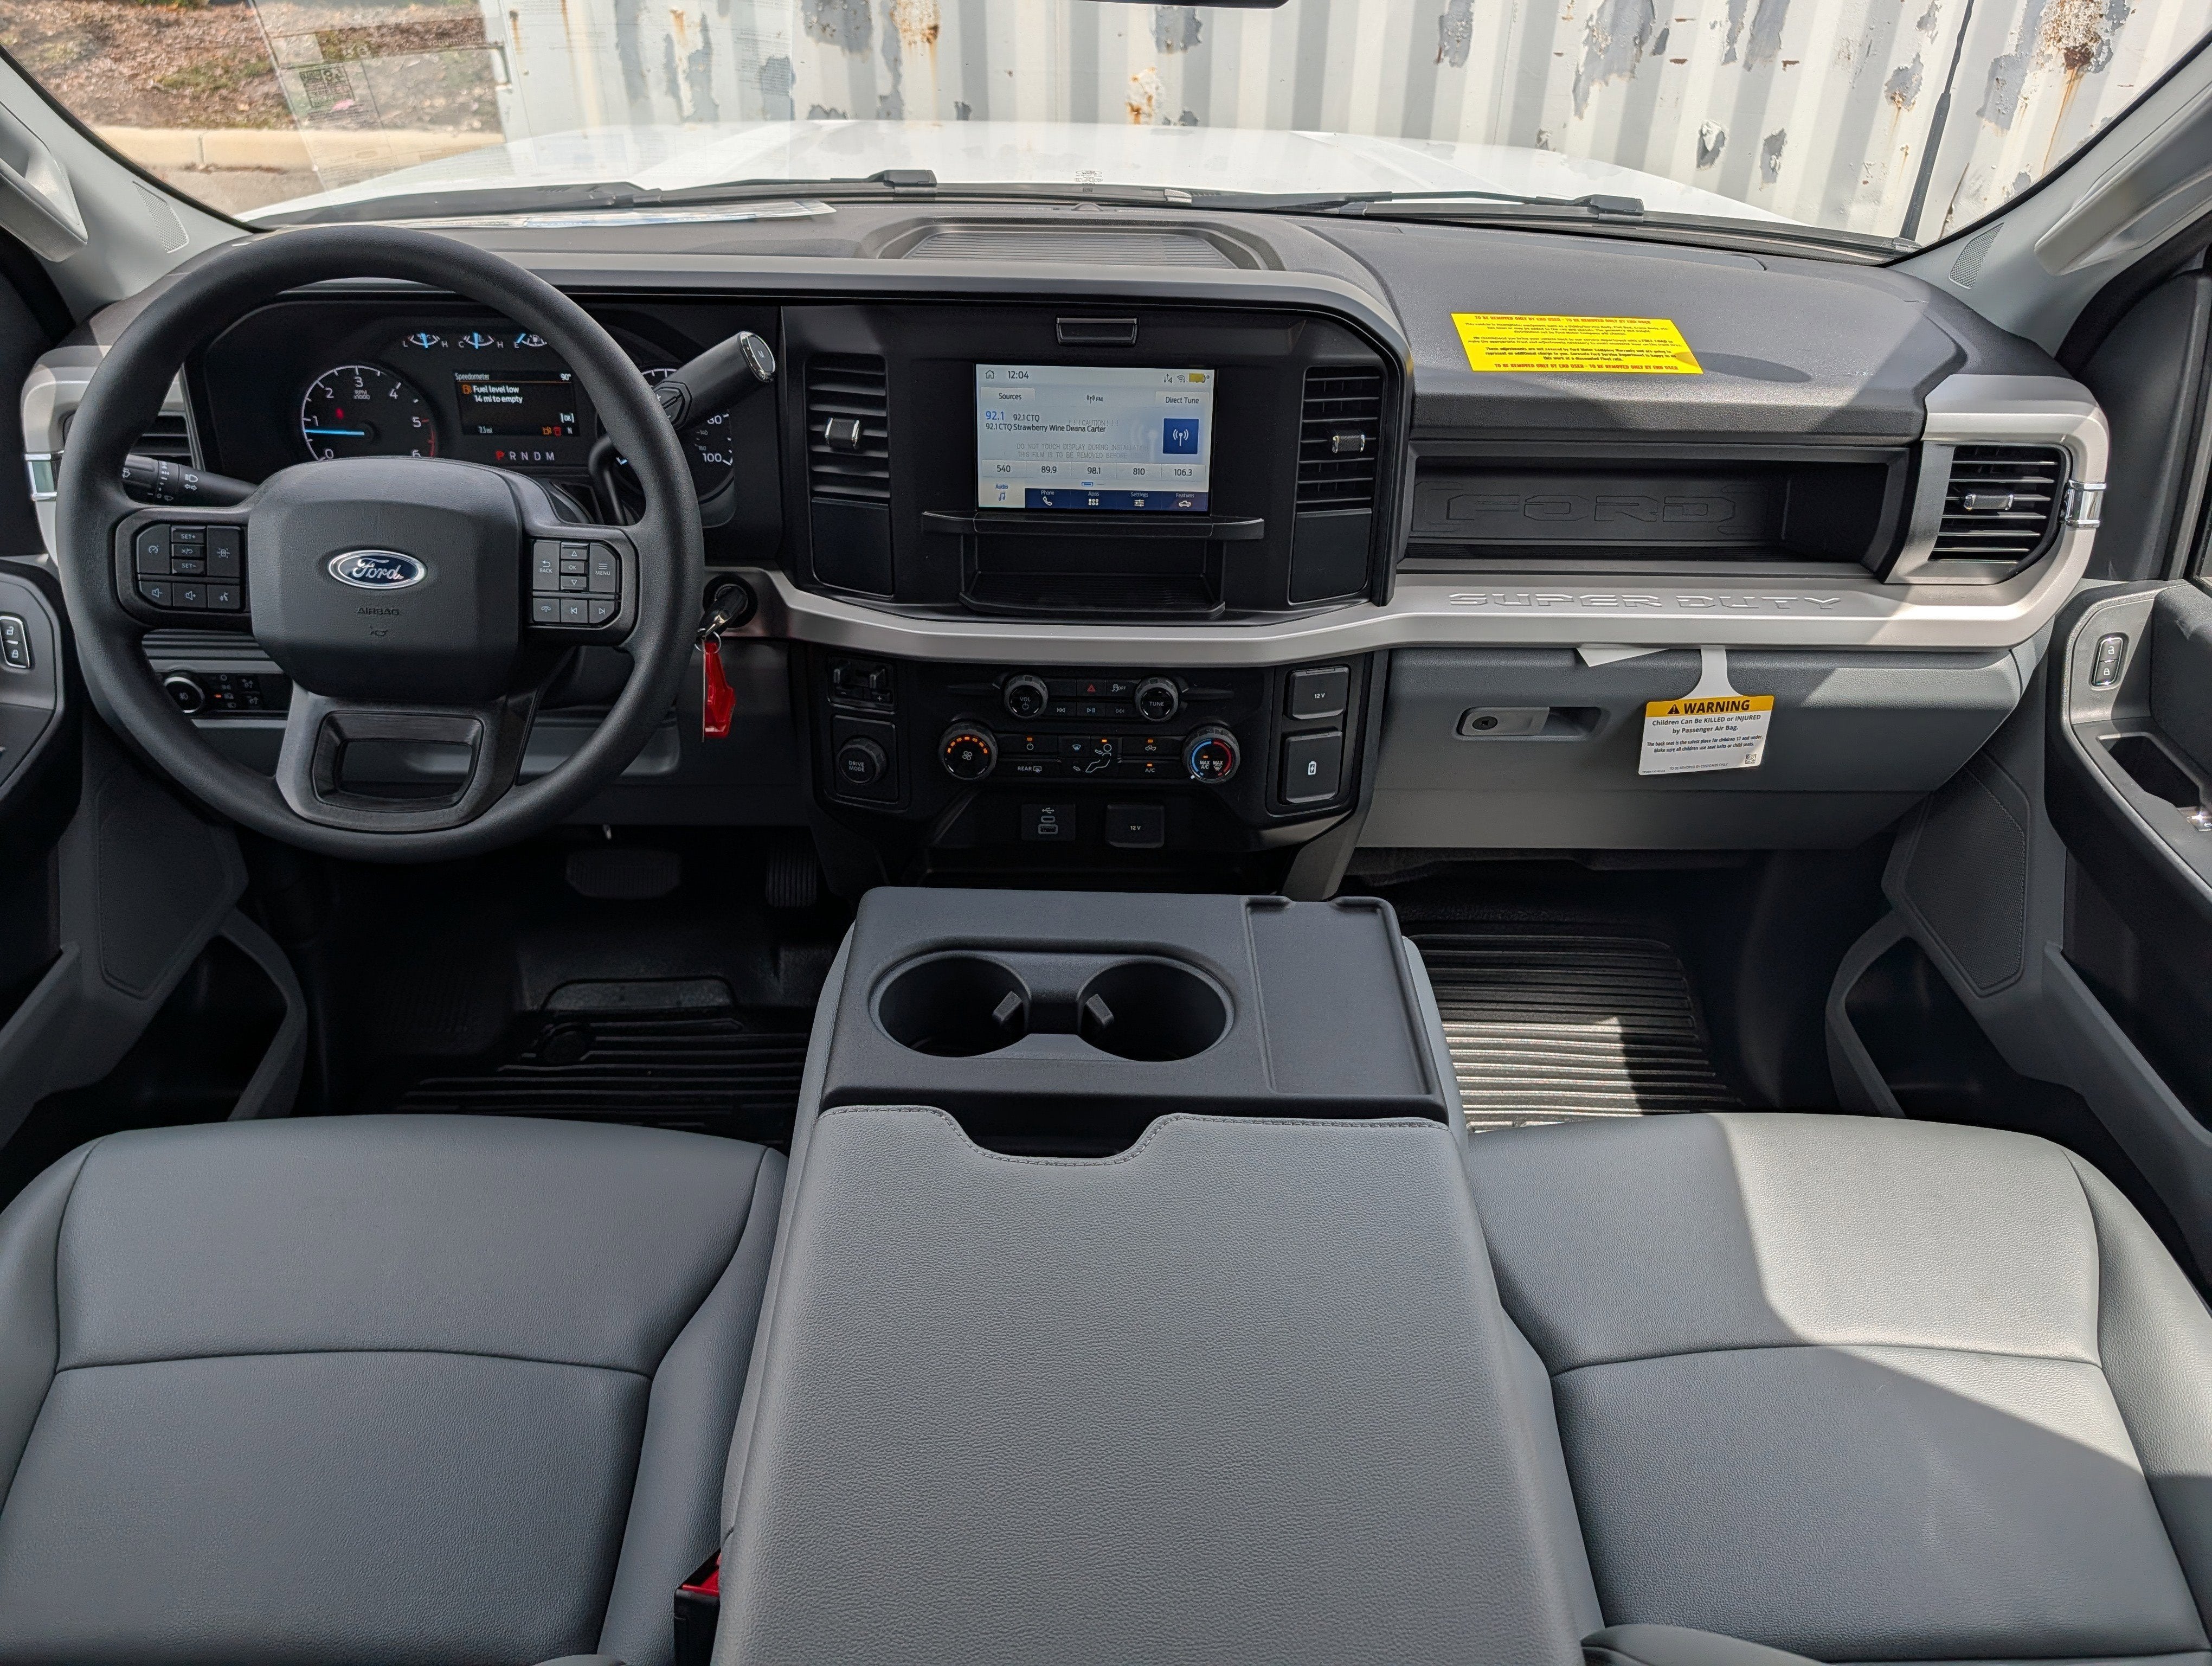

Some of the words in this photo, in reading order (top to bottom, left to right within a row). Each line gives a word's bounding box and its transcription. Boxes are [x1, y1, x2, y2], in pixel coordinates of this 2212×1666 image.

[454, 373, 490, 381] Speedometer
[1007, 370, 1029, 379] 12:04
[354, 376, 363, 388] 3
[325, 387, 334, 399] 2
[388, 388, 398, 399] 4
[472, 385, 488, 393] Fuel
[489, 385, 505, 393] level
[506, 385, 519, 393] low
[985, 411, 1004, 420] 92.1
[1026, 414, 1040, 422] CTQ
[312, 415, 319, 427] 1
[411, 416, 422, 428] 5
[999, 424, 1012, 432] CTQ
[1013, 424, 1047, 432] Strawberry
[325, 448, 334, 459] 0
[411, 449, 421, 457] 6
[495, 450, 505, 460] P
[509, 451, 517, 460] R
[520, 451, 529, 460] N
[533, 451, 541, 460] D
[545, 451, 555, 460] M
[703, 453, 722, 463] 100
[1447, 494, 1734, 523] FORD
[352, 558, 404, 580] Ford
[1449, 593, 1663, 608] SUPER
[1676, 595, 1841, 610] DUTY
[357, 607, 400, 616] AIRBAG
[1683, 700, 1750, 714] WARNING
